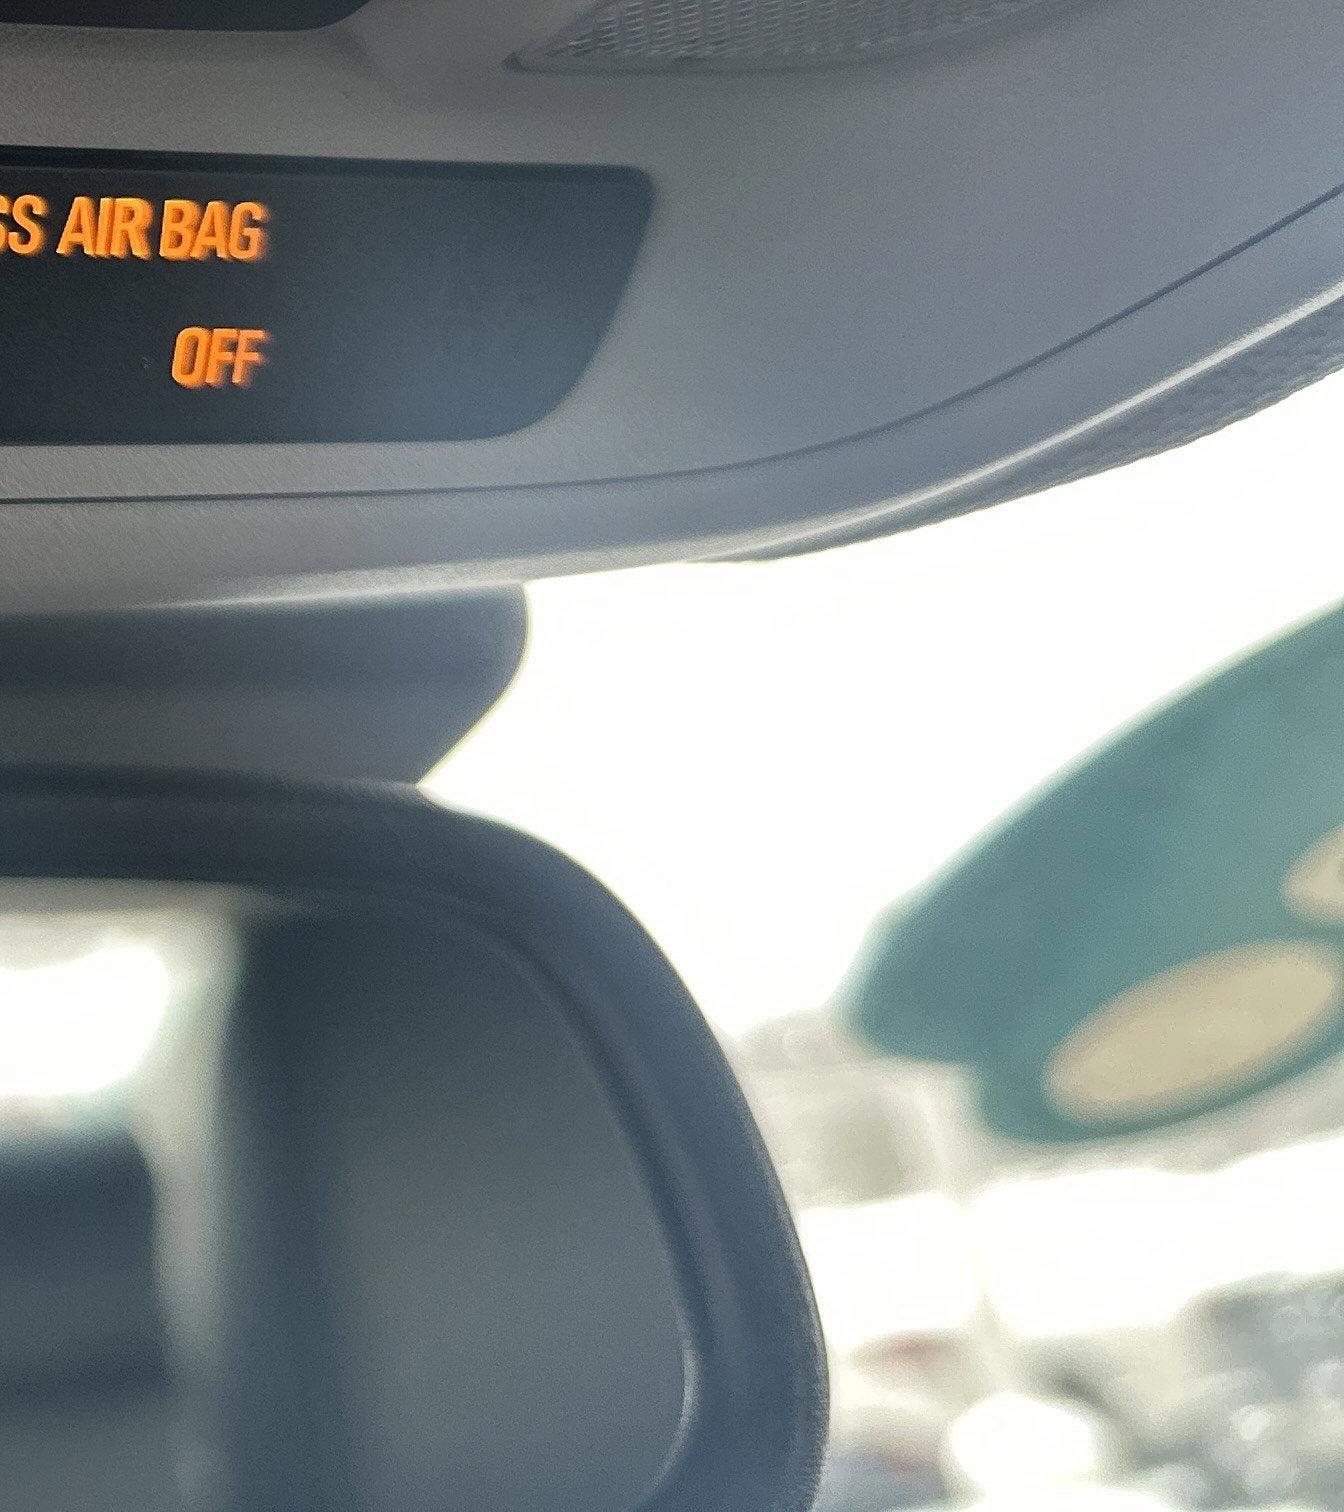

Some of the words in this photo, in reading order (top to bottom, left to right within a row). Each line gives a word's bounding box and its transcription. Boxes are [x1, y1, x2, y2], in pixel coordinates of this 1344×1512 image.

[56, 196, 153, 260] AIR
[159, 199, 269, 262] BAG
[171, 327, 269, 389] OFF
